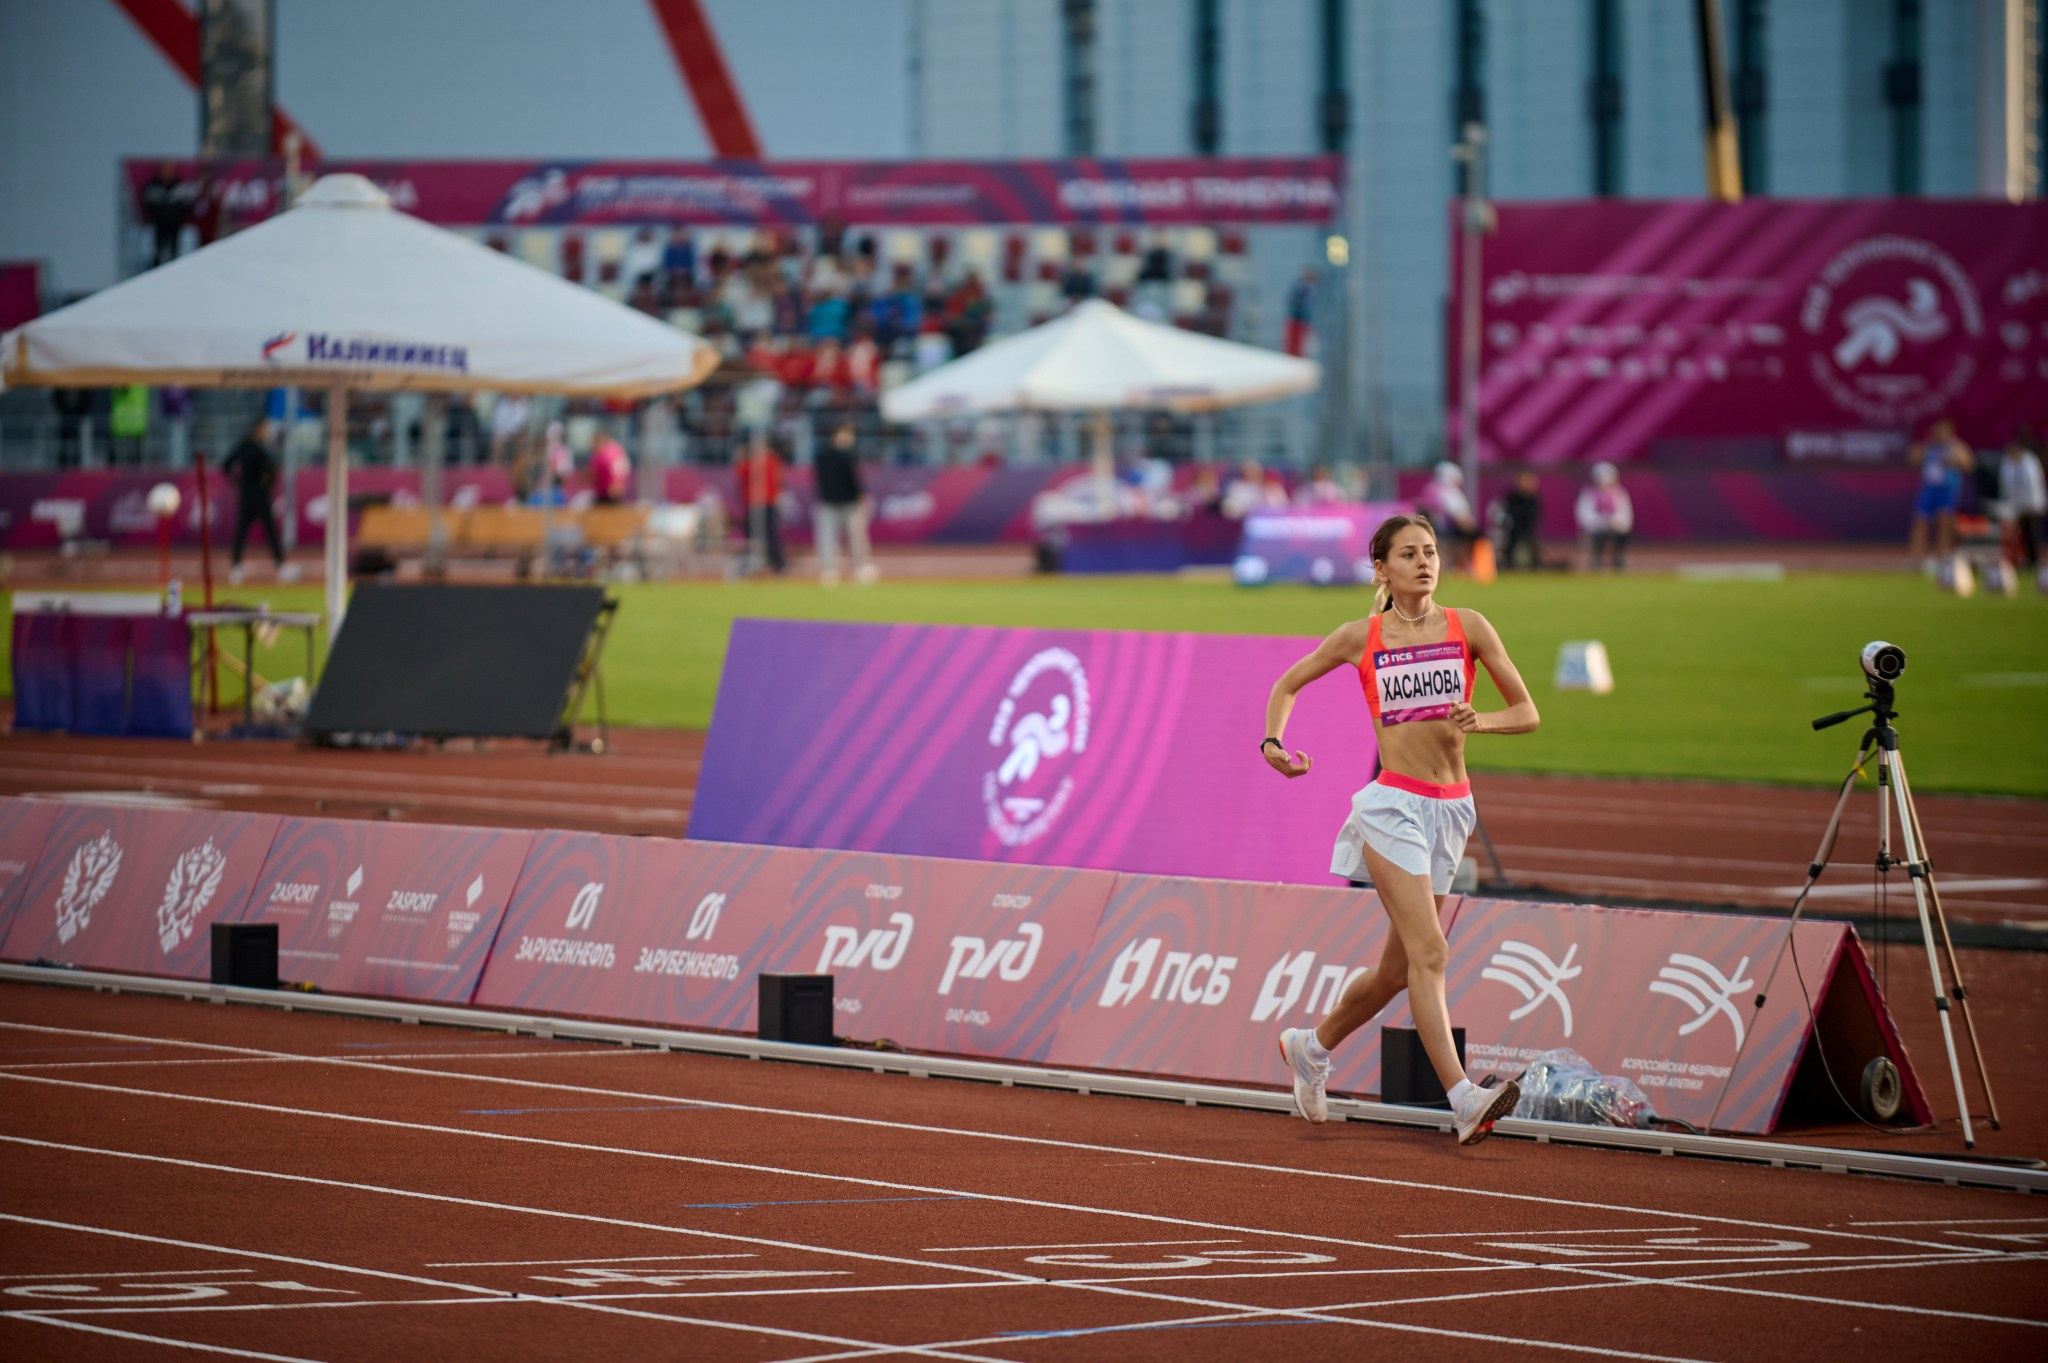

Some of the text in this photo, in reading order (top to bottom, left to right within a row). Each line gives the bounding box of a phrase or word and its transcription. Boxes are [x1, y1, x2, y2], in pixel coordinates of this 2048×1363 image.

[1391, 652, 1413, 663] ПСБ
[1382, 669, 1461, 702] ХАСАНОВА
[270, 882, 319, 904] ZASPORT
[387, 890, 438, 912] ZASPORT
[515, 935, 616, 969] ЗАРУБЕЖНЕФТЬ
[634, 946, 740, 981] ЗАРУБЕЖНЕФТЬ
[1151, 951, 1238, 1005] ПСБ
[1621, 1057, 1688, 1075] ВСЕРОССИЙСКАЯ
